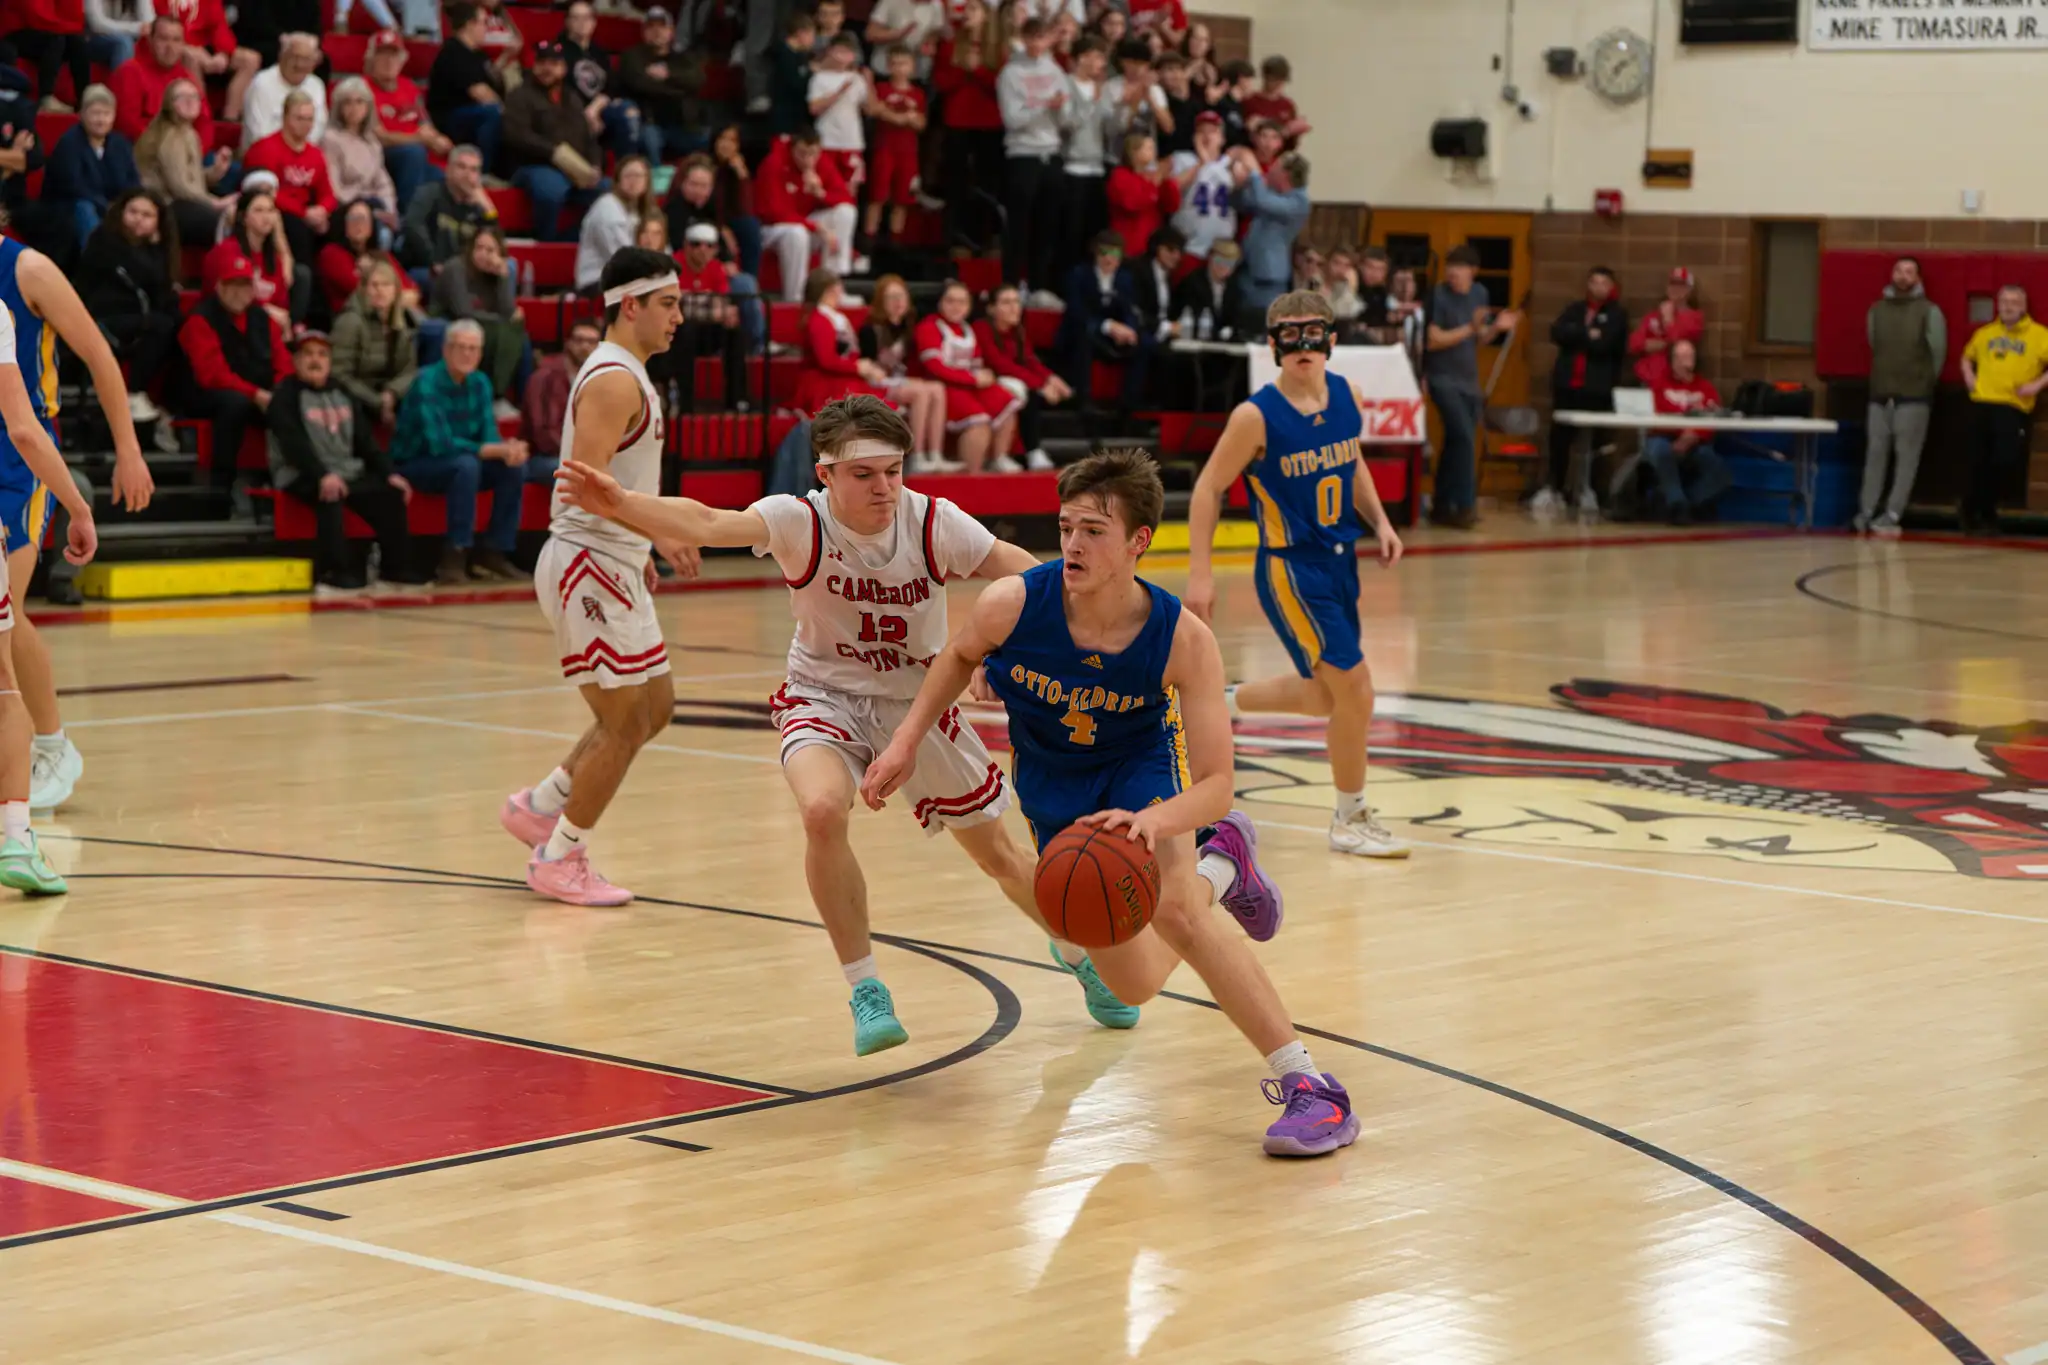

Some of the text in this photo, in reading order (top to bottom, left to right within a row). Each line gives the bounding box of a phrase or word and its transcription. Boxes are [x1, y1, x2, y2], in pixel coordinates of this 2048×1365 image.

[1829, 17, 1882, 39] MIKE
[1892, 16, 2007, 39] TOMASURA
[1193, 182, 1228, 217] 44
[1316, 474, 1342, 527] 0
[827, 575, 930, 607] CAMERON
[858, 611, 907, 649] 12
[1059, 709, 1098, 746] 4
